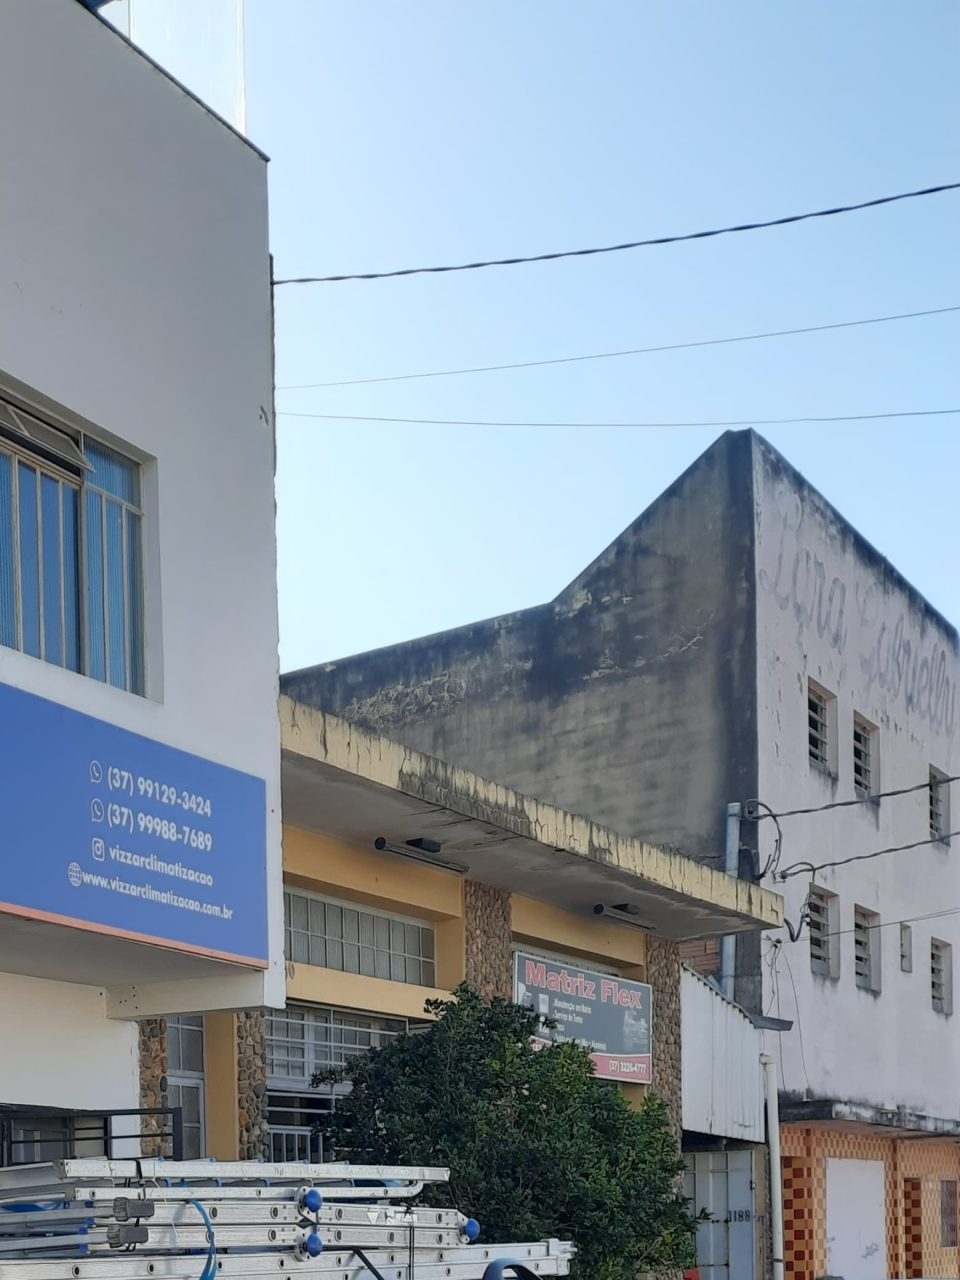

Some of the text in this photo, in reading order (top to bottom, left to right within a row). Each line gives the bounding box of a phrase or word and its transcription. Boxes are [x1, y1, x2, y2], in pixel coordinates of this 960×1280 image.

[107, 766, 212, 817] (37) 99129-3424
[107, 803, 212, 851] (37) 99988-7689
[109, 845, 213, 886] vizzarclimatizacao
[81, 871, 233, 920] www.vizzarclimatizacao.com.br
[525, 960, 642, 1009] Matriz Flex
[728, 1210, 751, 1222] 1188
